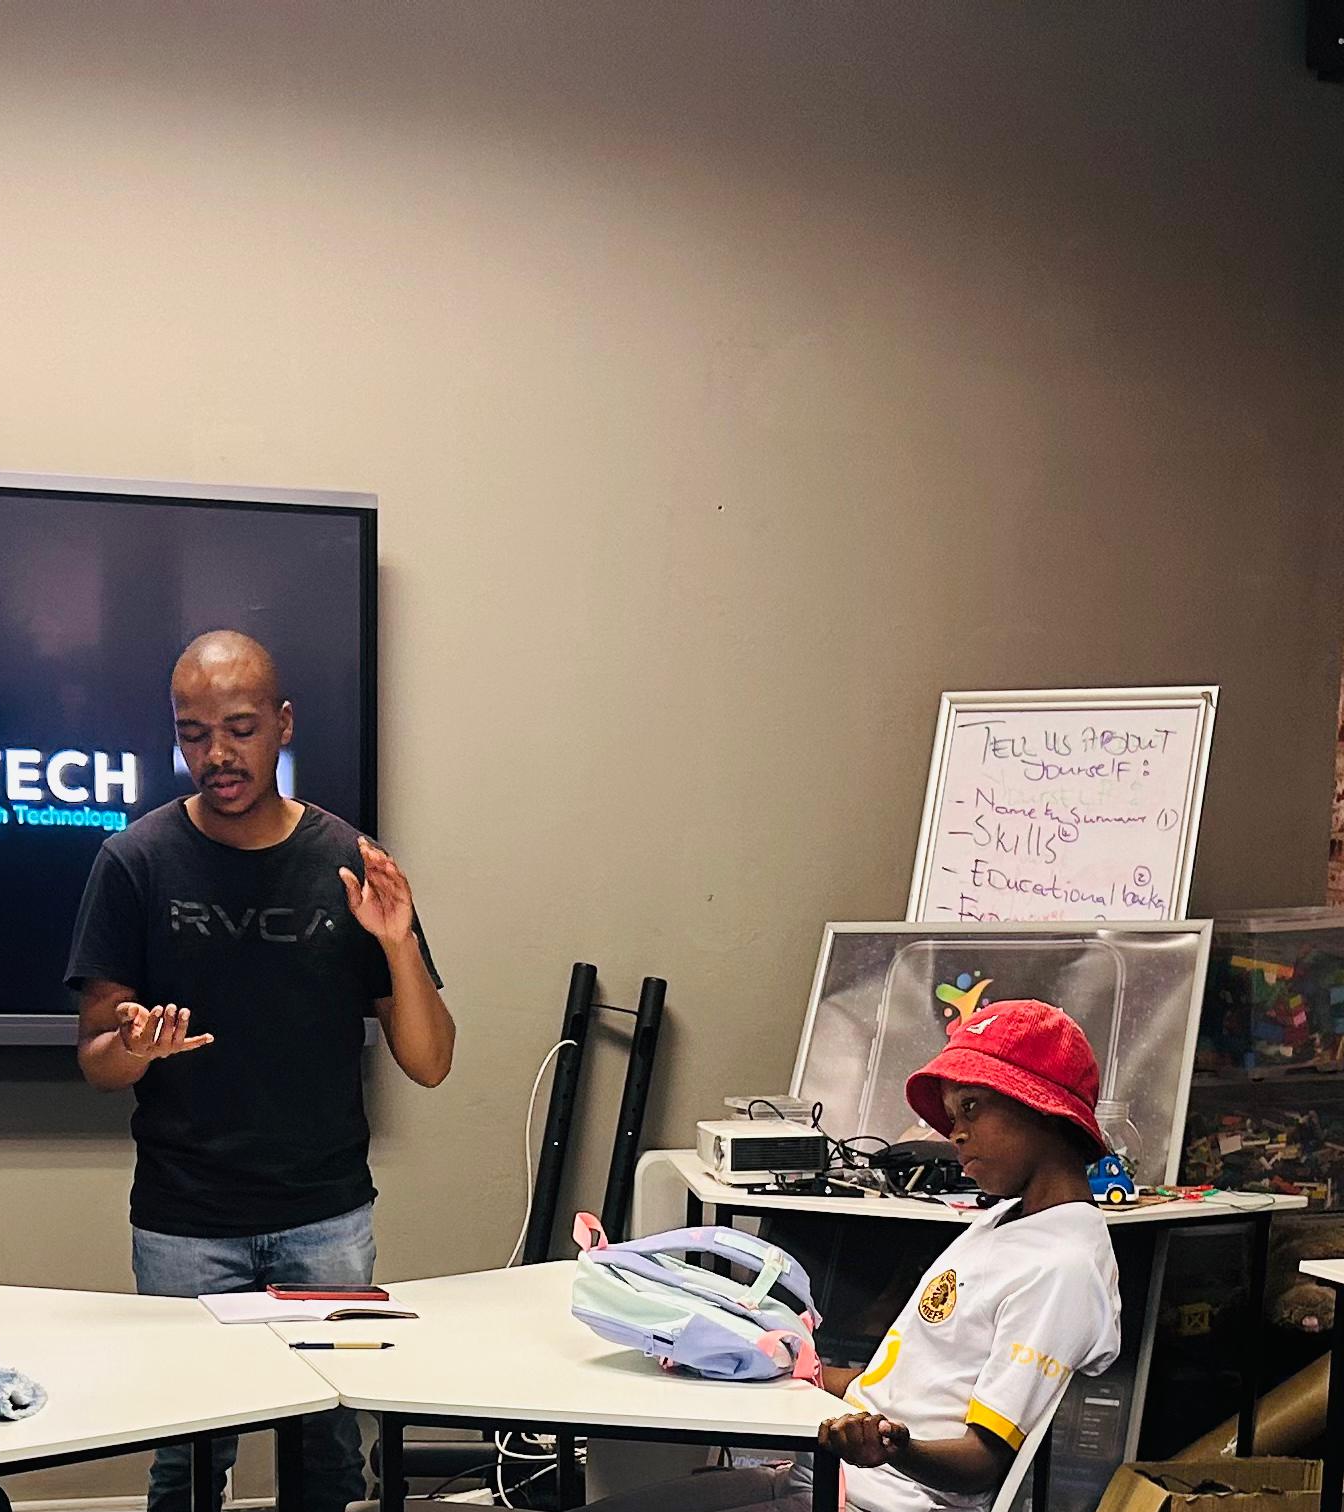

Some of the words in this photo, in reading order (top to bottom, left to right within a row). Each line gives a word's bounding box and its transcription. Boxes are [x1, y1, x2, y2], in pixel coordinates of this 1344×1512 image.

[12, 804, 127, 831] Technology
[975, 788, 1037, 820] Name
[972, 814, 1057, 864] Skills
